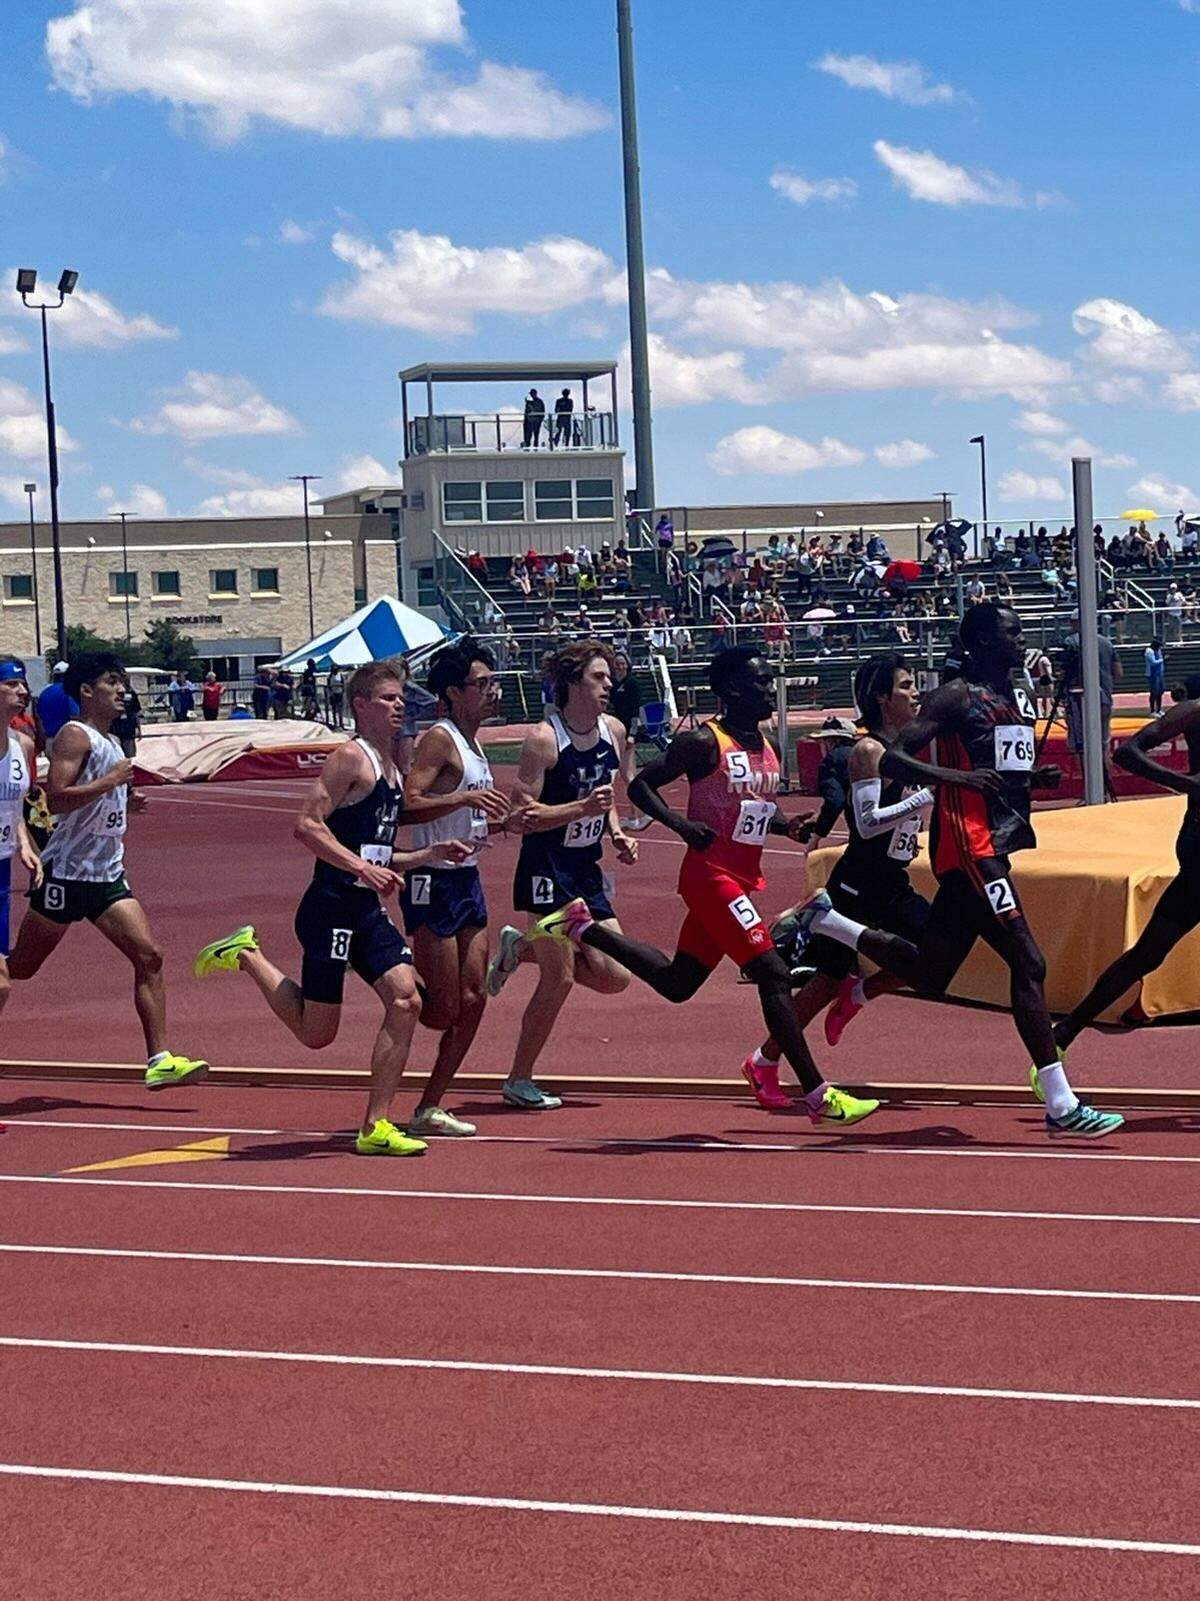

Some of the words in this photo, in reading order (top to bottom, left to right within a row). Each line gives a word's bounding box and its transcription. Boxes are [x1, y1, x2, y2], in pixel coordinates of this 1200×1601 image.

[1017, 691, 1033, 716] 2
[1002, 740, 1033, 762] 769
[11, 758, 23, 781] 3
[731, 754, 747, 779] 5
[105, 810, 124, 829] 95
[570, 819, 602, 840] 318
[742, 814, 773, 837] 61
[47, 885, 63, 908] 9
[414, 877, 427, 901] 7
[535, 878, 550, 902] 4
[989, 882, 1012, 911] 2
[733, 899, 755, 924] 5
[333, 930, 349, 958] 8
